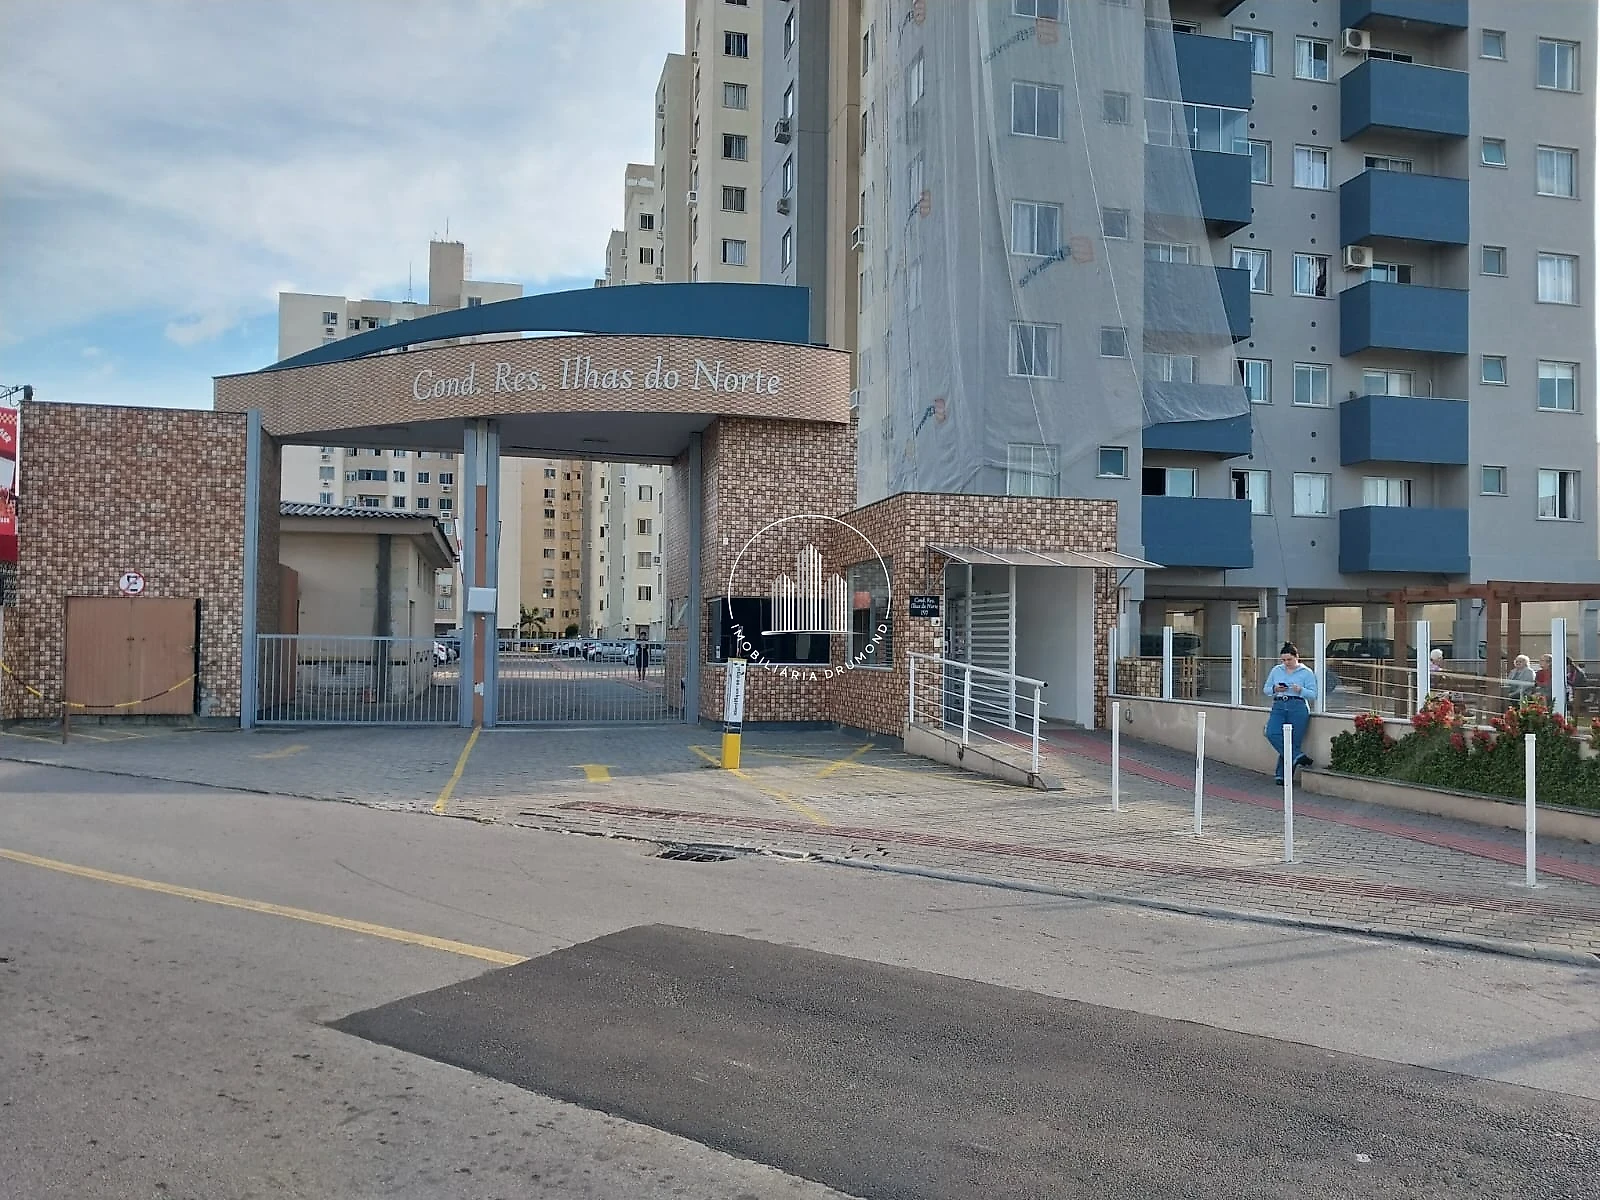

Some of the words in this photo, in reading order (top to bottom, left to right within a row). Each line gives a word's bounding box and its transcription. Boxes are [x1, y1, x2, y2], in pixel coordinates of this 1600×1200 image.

[412, 362, 481, 400] Cond.
[494, 362, 548, 393] Res.
[559, 356, 633, 391] Ilhas
[645, 355, 679, 391] do
[692, 359, 781, 395] Norte
